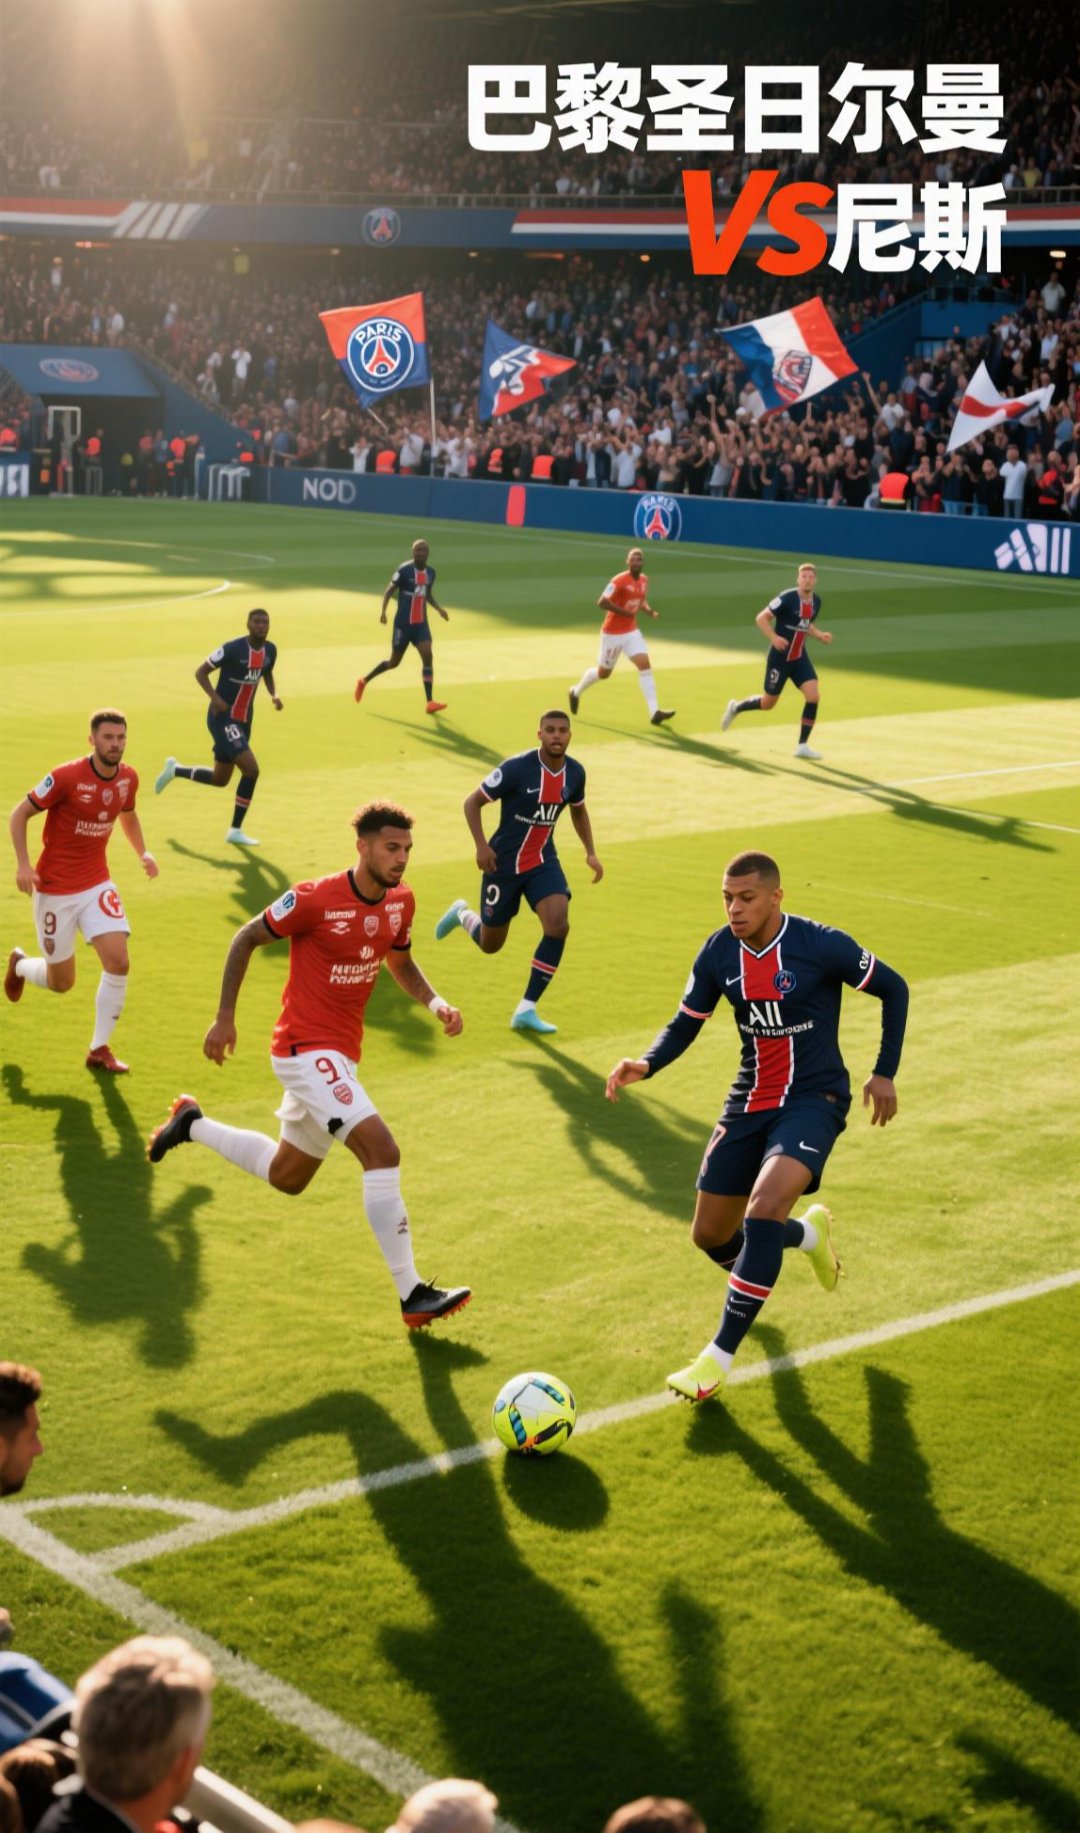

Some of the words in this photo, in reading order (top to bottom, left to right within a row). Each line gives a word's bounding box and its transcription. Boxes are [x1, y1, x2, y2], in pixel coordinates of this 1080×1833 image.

[355, 323, 403, 345] PARIS
[303, 477, 356, 504] NOD
[44, 911, 57, 936] 9
[315, 1056, 341, 1085] 9
